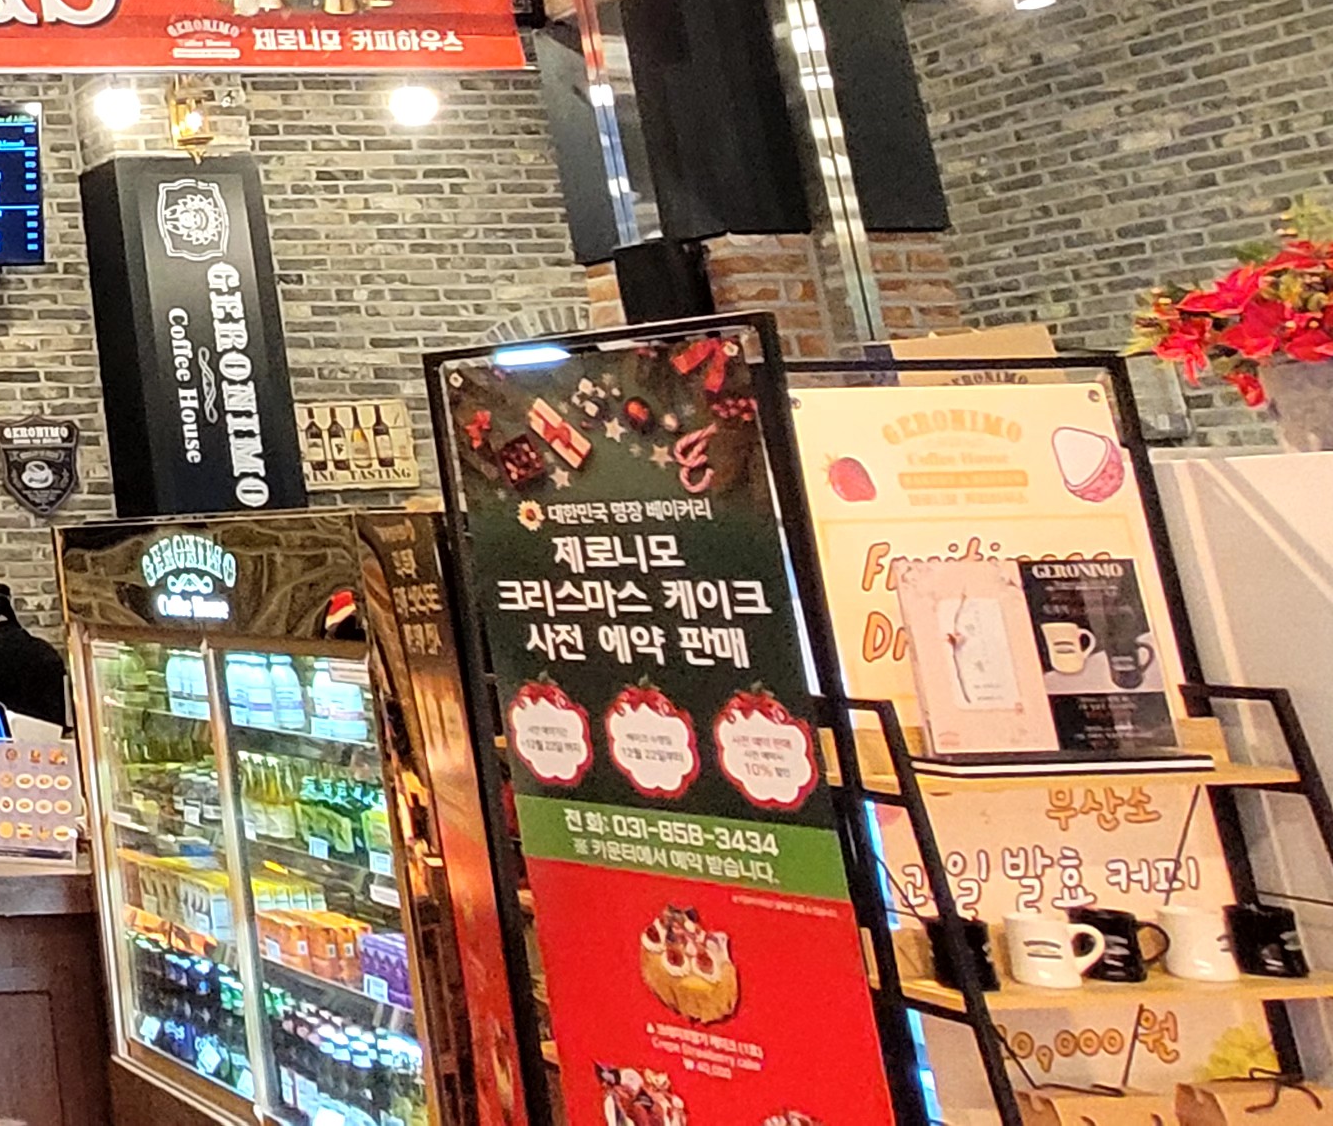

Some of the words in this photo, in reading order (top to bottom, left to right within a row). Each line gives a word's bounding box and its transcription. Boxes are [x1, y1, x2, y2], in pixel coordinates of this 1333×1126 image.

[252, 28, 343, 52] 제로니모
[351, 29, 464, 52] 커피하우스
[168, 306, 194, 383] Coffee
[206, 261, 271, 509] GERONIMO
[939, 370, 1029, 385] ERONIMO
[3, 426, 69, 439] GERONIMO
[177, 386, 203, 465] House
[881, 408, 1023, 446] GERONIMO
[349, 467, 411, 481] TASTING
[547, 502, 608, 526] 대한민국
[610, 501, 643, 524] 명장
[646, 497, 713, 522] 베이커리
[140, 534, 237, 589] GERONIMO
[552, 533, 686, 575] 제로니모
[1031, 562, 1125, 579] GERONIMO
[497, 579, 654, 618] 크리스마스
[662, 579, 773, 620] 케이크
[526, 623, 587, 663] 사전
[598, 625, 666, 666] 예약
[679, 627, 752, 669] 판매
[743, 762, 773, 777] 10%
[1045, 786, 1162, 831] 무산소
[611, 814, 780, 857] 031-858-3434
[591, 838, 669, 869] 카운터에서
[669, 850, 704, 874] 예약
[705, 853, 782, 885] 받습니다.
[1003, 844, 1097, 914] 발효
[1105, 856, 1200, 894] 커피
